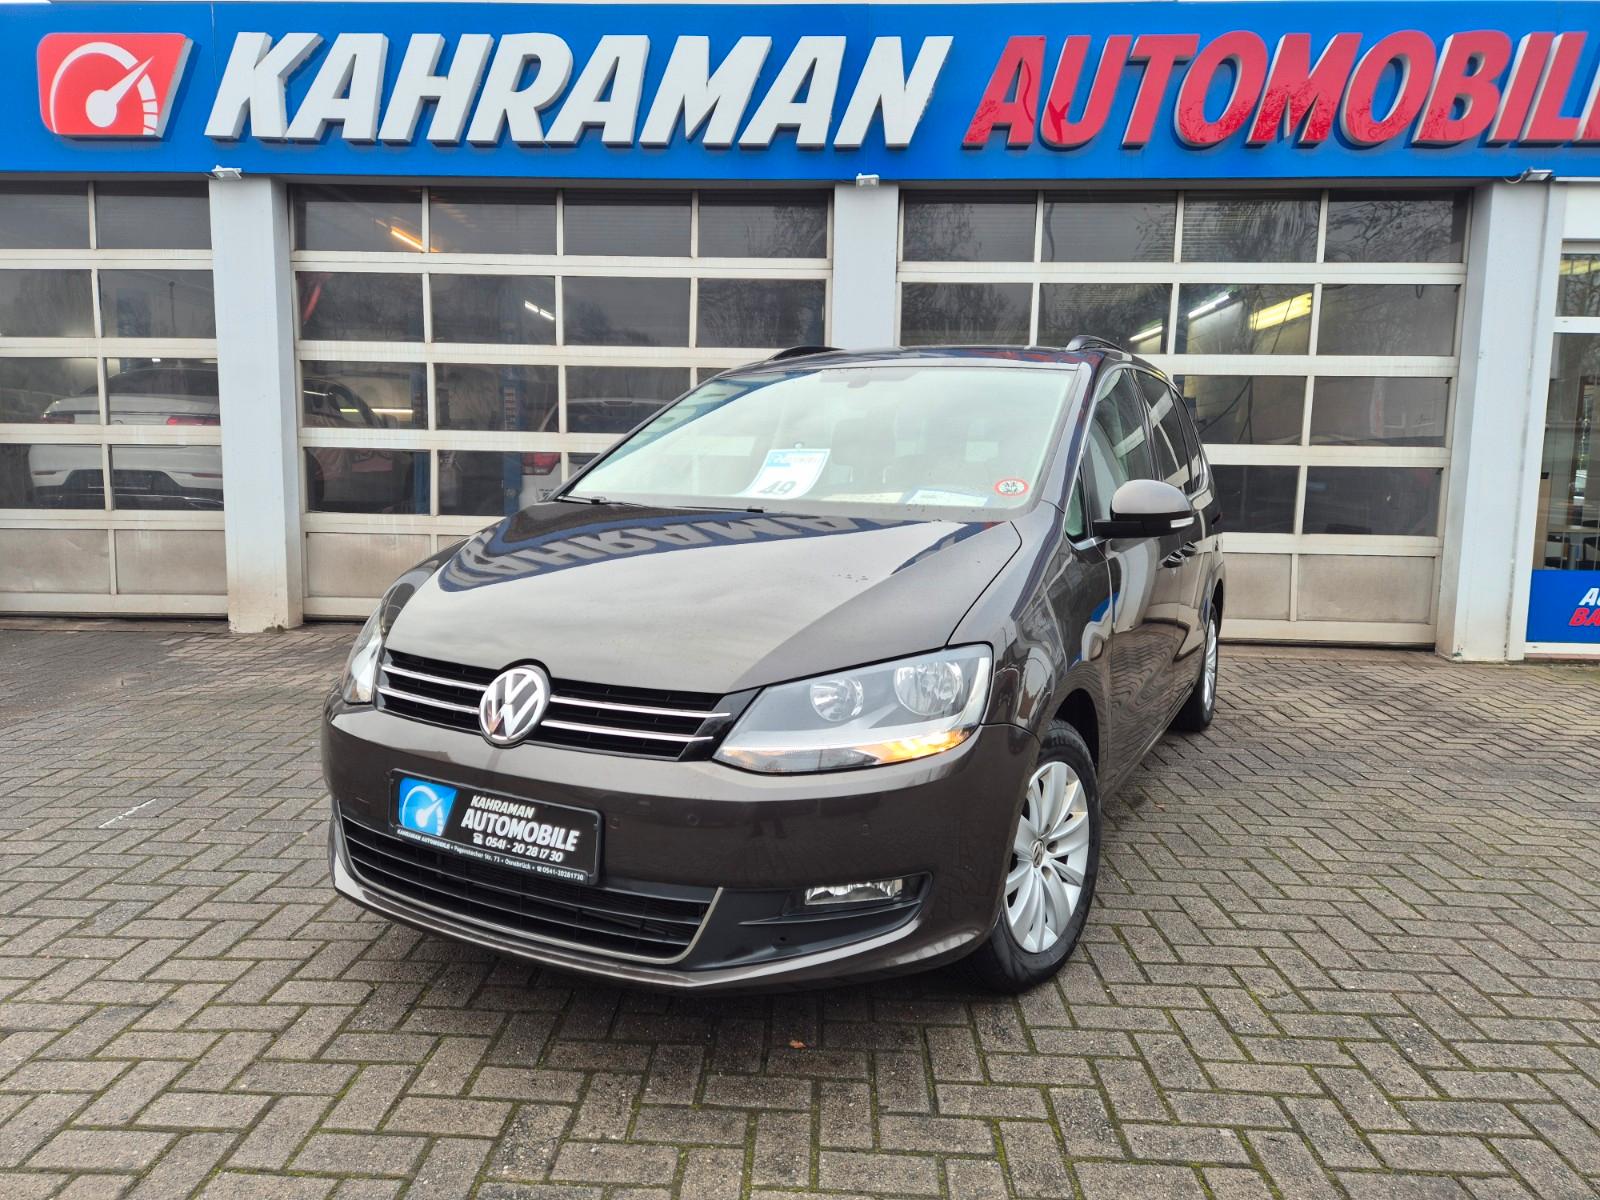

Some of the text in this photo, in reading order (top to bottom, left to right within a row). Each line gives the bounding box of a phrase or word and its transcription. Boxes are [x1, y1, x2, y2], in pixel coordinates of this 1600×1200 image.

[204, 29, 1600, 149] KAHRAMAN AUTOMOBIL
[480, 666, 549, 742] VW
[470, 795, 536, 819] KAHRAMAN
[460, 808, 580, 852] AUTOMOBILE
[485, 836, 506, 850] 0541
[512, 842, 525, 854] 20
[526, 845, 538, 857] 28
[539, 848, 549, 859] 17
[549, 850, 564, 863] 30
